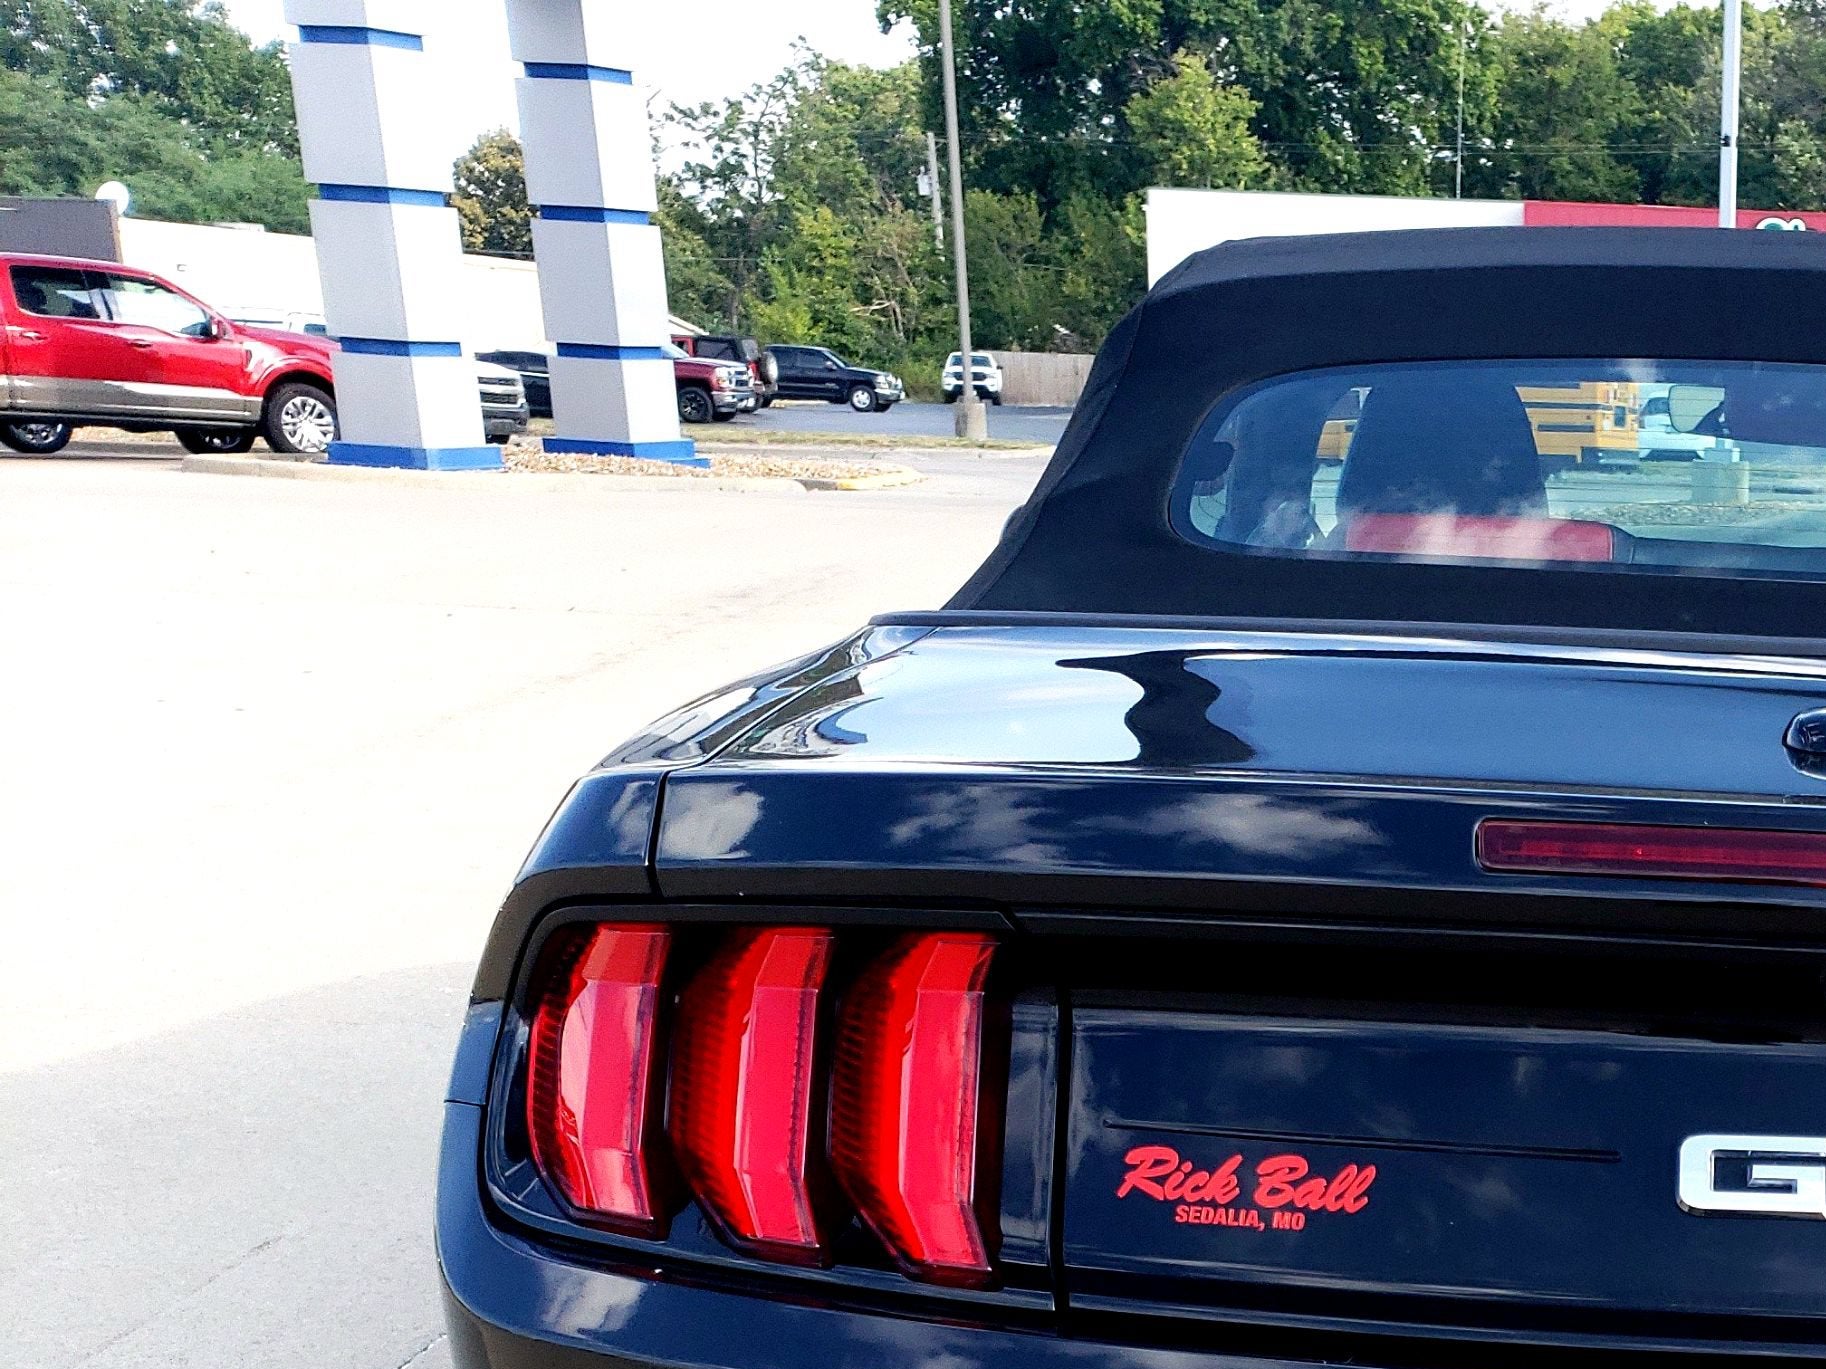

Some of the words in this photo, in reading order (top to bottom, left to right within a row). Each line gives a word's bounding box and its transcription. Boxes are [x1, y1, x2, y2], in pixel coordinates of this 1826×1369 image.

[1116, 1144, 1243, 1204] Rick
[1253, 1154, 1377, 1213] Ball
[1175, 1205, 1265, 1231] SEDALIA,
[1272, 1211, 1306, 1231] MO
